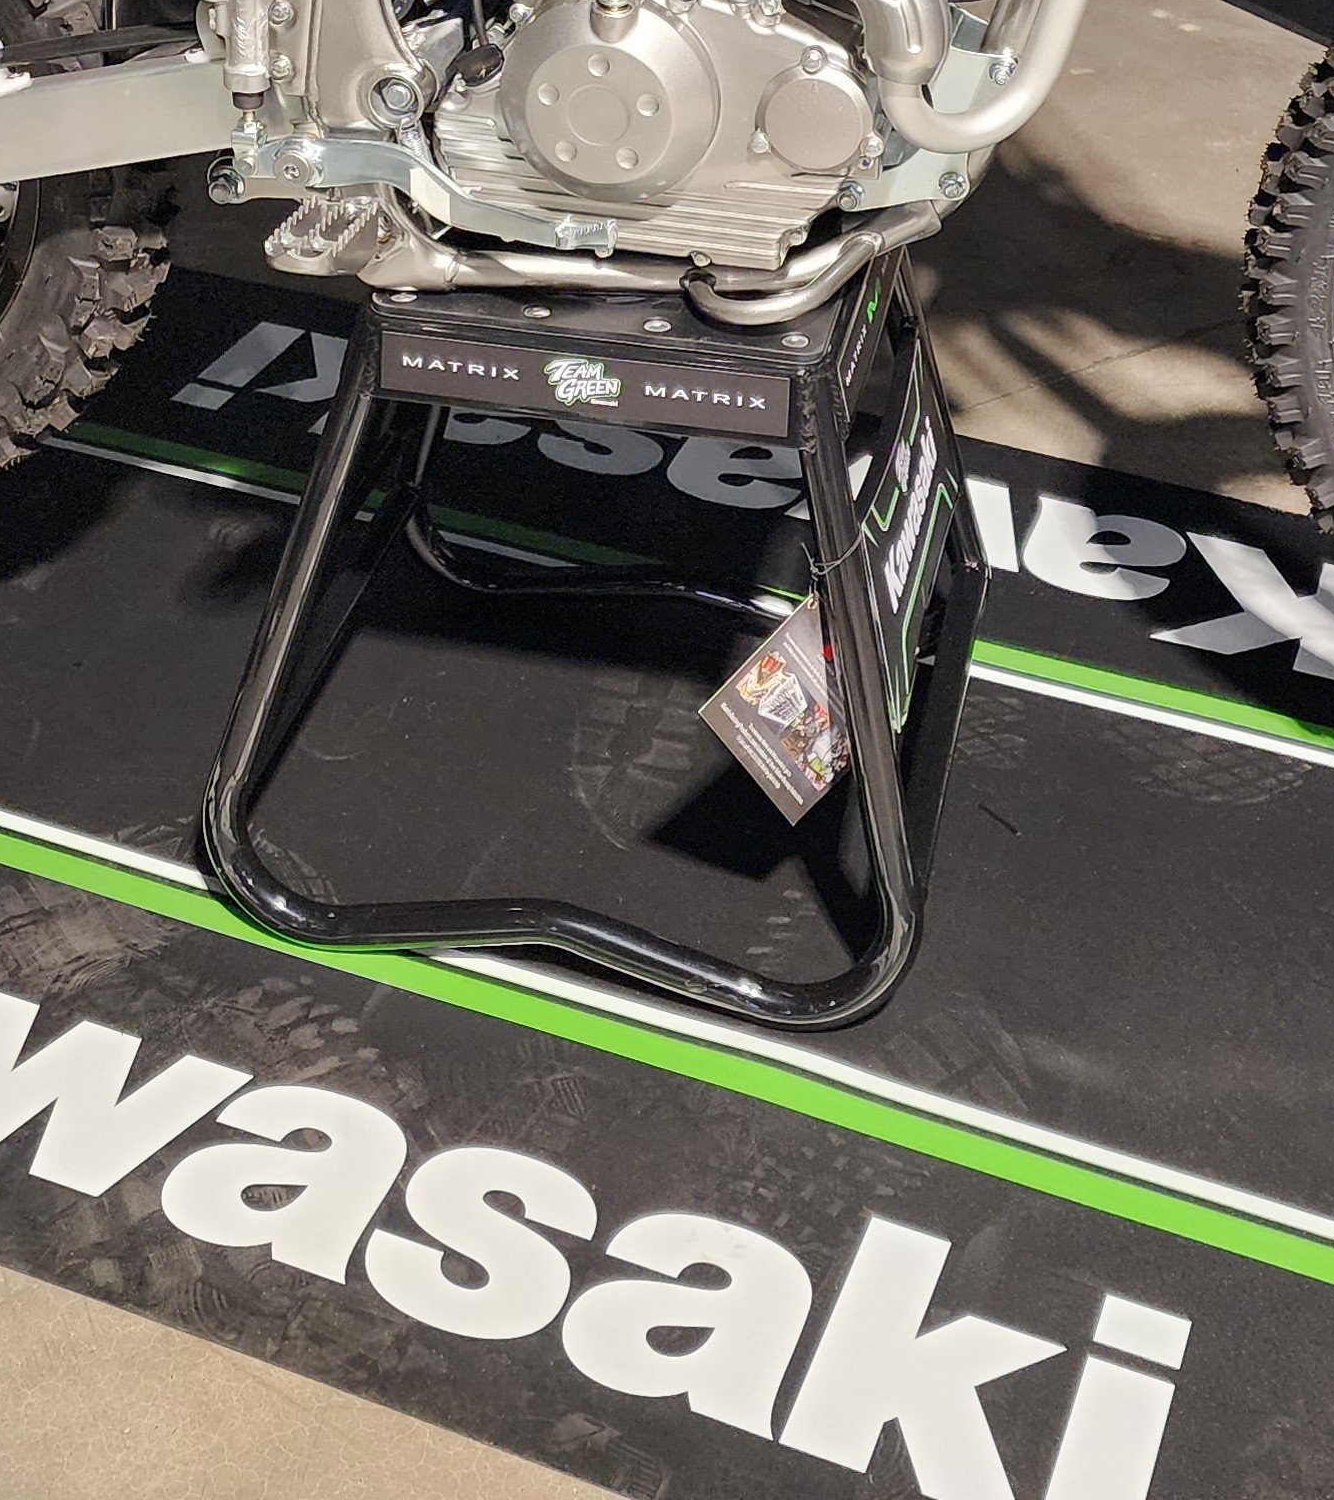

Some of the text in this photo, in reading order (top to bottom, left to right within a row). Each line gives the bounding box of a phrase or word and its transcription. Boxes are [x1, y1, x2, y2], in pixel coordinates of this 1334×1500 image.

[401, 355, 520, 381] MATRIX
[845, 324, 868, 387] MATRIX
[546, 360, 603, 382] TEAM
[557, 378, 619, 403] GREEN
[644, 383, 767, 410] MATRIX
[883, 415, 938, 615] Kawasaki
